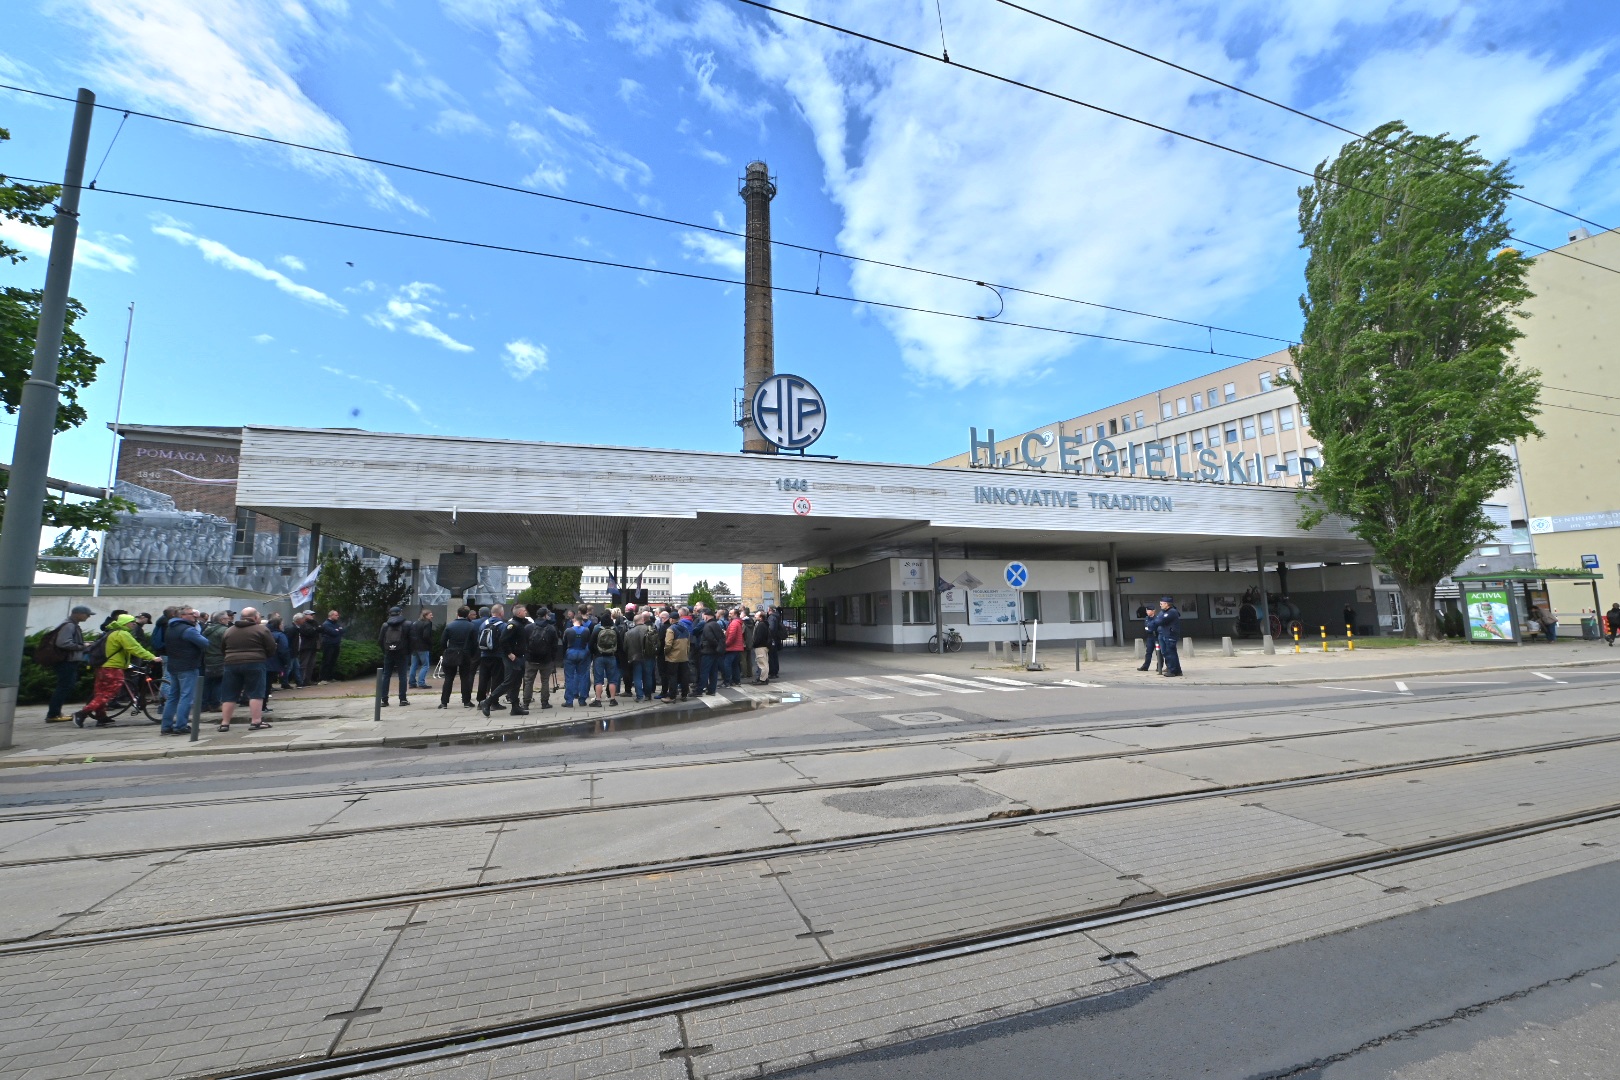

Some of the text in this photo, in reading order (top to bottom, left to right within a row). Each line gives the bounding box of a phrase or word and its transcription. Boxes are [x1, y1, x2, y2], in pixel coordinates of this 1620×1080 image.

[136, 447, 206, 461] POMAGA
[776, 477, 808, 491] 1846
[974, 486, 1173, 512] INNOVATIVE TRADITION
[1553, 514, 1596, 524] CENTRUM
